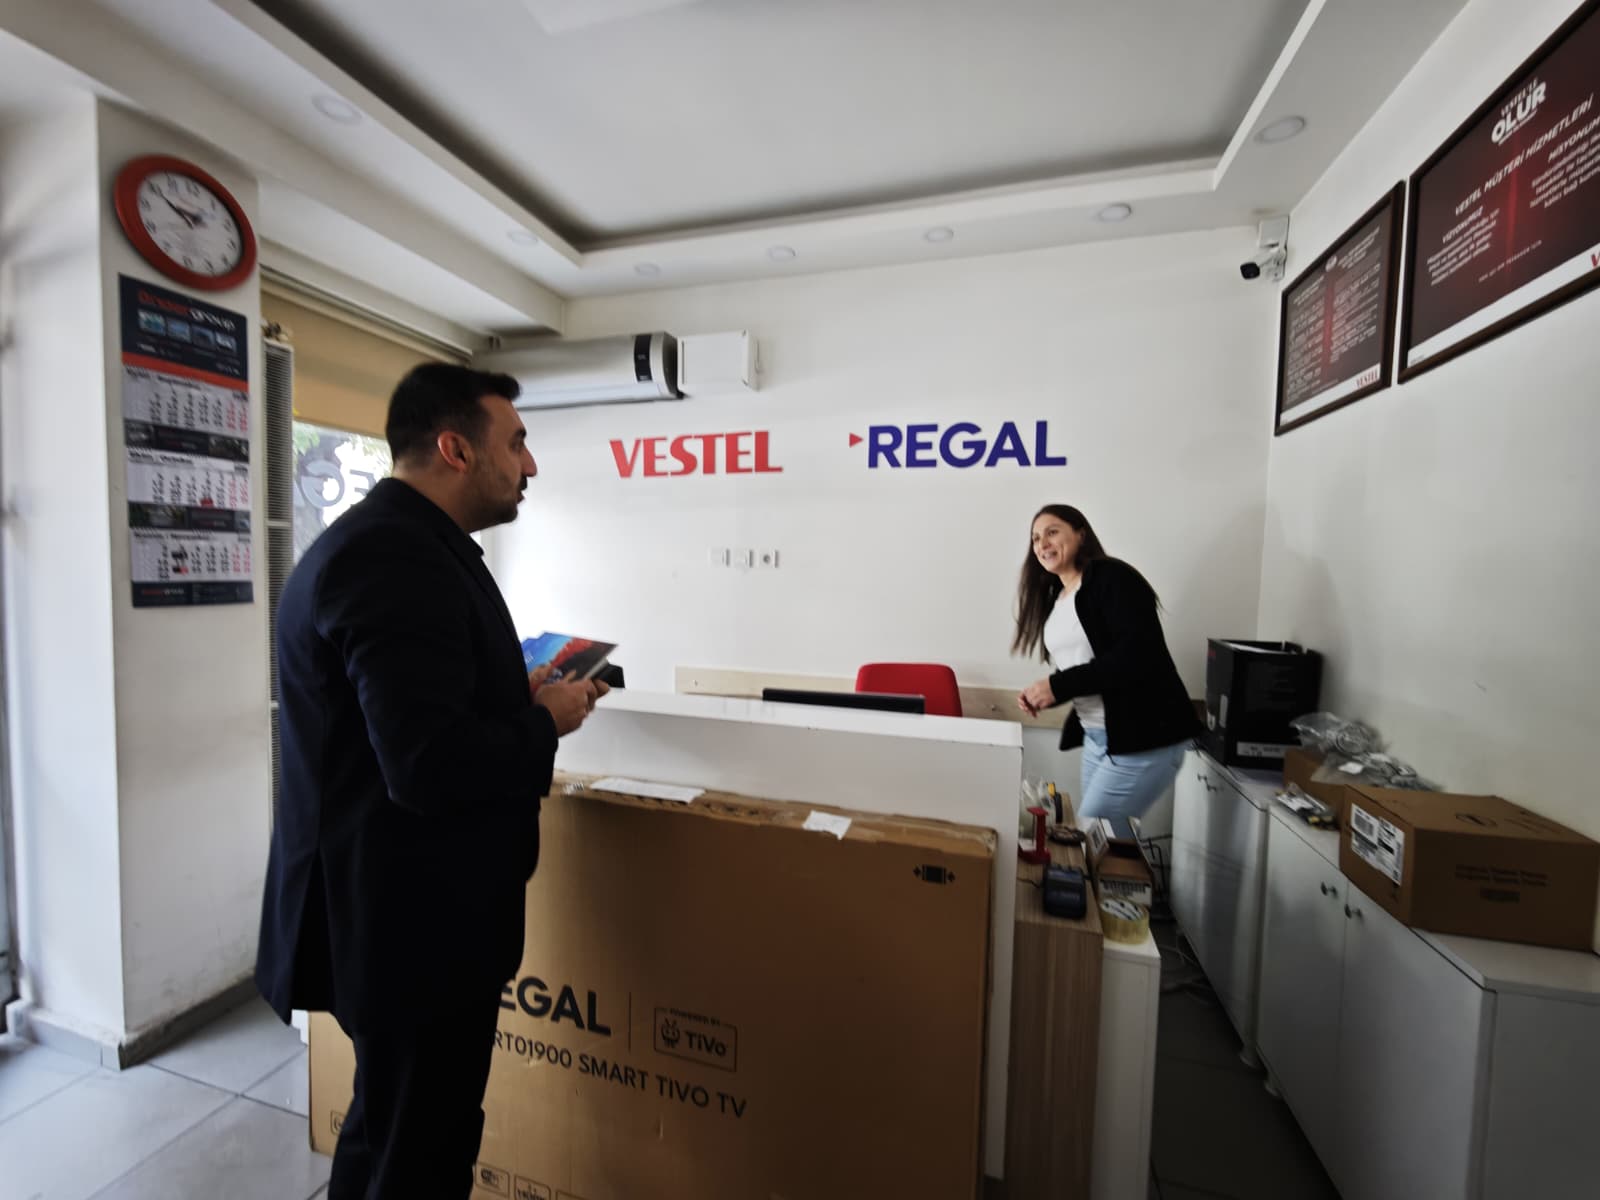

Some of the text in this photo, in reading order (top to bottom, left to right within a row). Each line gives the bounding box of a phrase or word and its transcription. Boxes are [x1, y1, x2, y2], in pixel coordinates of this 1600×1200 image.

[1491, 81, 1547, 144] OLUR
[1455, 187, 1482, 216] VESTEL
[1484, 150, 1525, 192] MÜŞTERİ
[1525, 92, 1594, 160] HİZMETLERİ
[609, 431, 783, 479] VESTEL
[867, 420, 1067, 469] REGAL
[685, 1030, 727, 1056] TiVo
[578, 1053, 649, 1091] SMART
[655, 1075, 709, 1108] TIVO
[716, 1092, 748, 1118] TV
